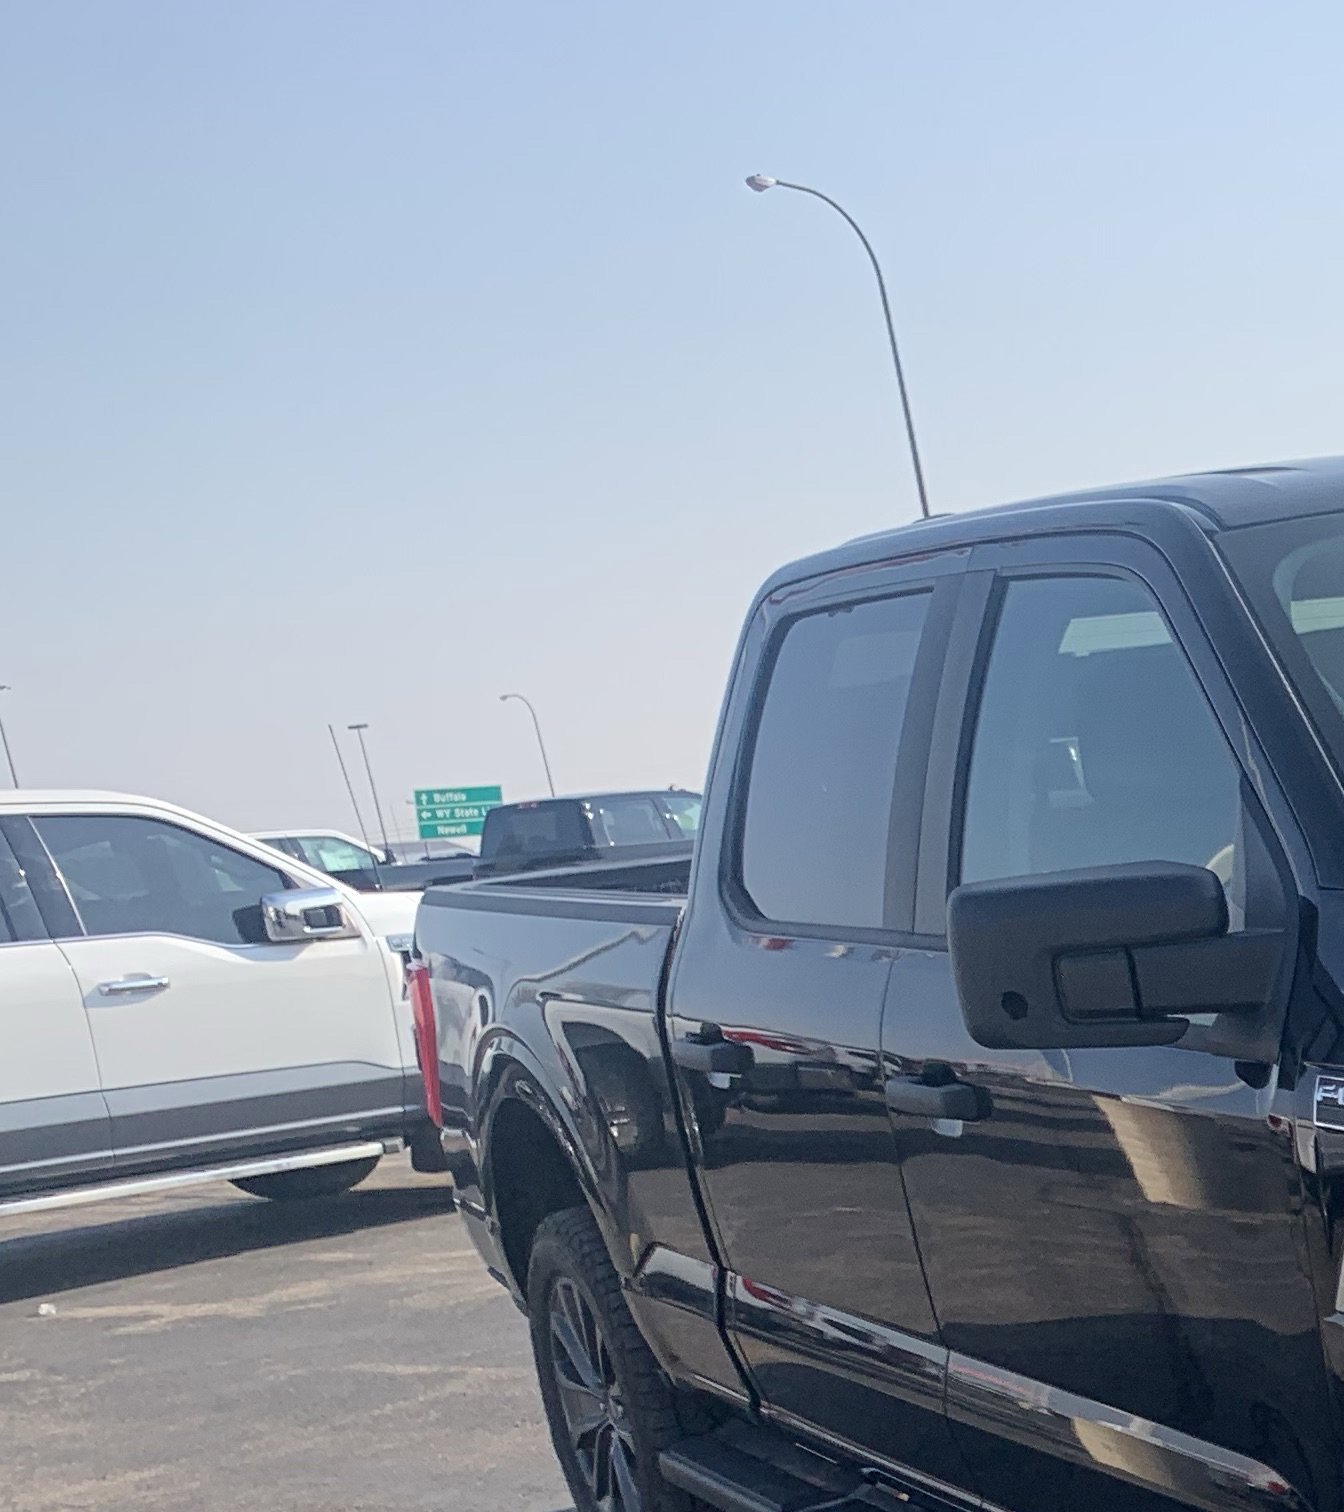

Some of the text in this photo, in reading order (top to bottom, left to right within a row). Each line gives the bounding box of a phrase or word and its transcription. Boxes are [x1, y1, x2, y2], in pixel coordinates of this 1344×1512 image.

[433, 793, 466, 803] Buffalo
[435, 808, 451, 818] WY
[454, 807, 479, 818] State
